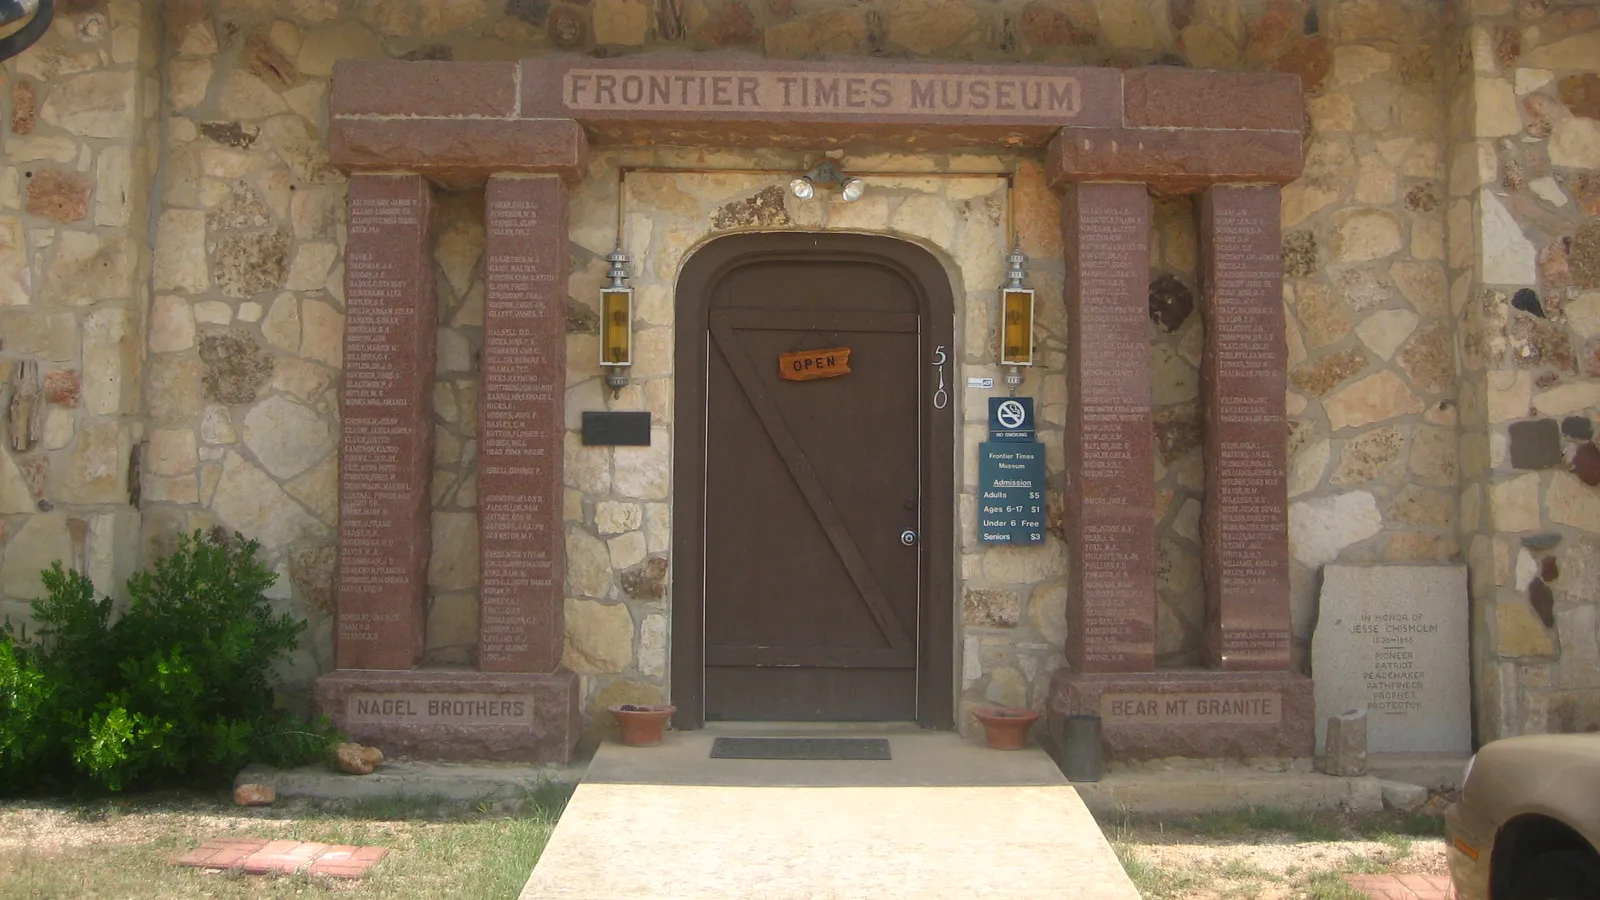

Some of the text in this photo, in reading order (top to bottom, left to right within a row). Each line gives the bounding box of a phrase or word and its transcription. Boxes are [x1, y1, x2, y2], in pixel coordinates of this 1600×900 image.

[570, 74, 1074, 111] FRONTIER TIMES MUSEUM
[793, 355, 835, 372] OPEN
[932, 345, 948, 409] 510
[1411, 613, 1424, 621] OF
[1349, 624, 1438, 633] JESSE CHISHOLM
[357, 700, 524, 717] NAGEL BROTHERS
[1112, 699, 1272, 716] BEAR MT. GRANITE
[1367, 701, 1422, 709] PROTECTOR
